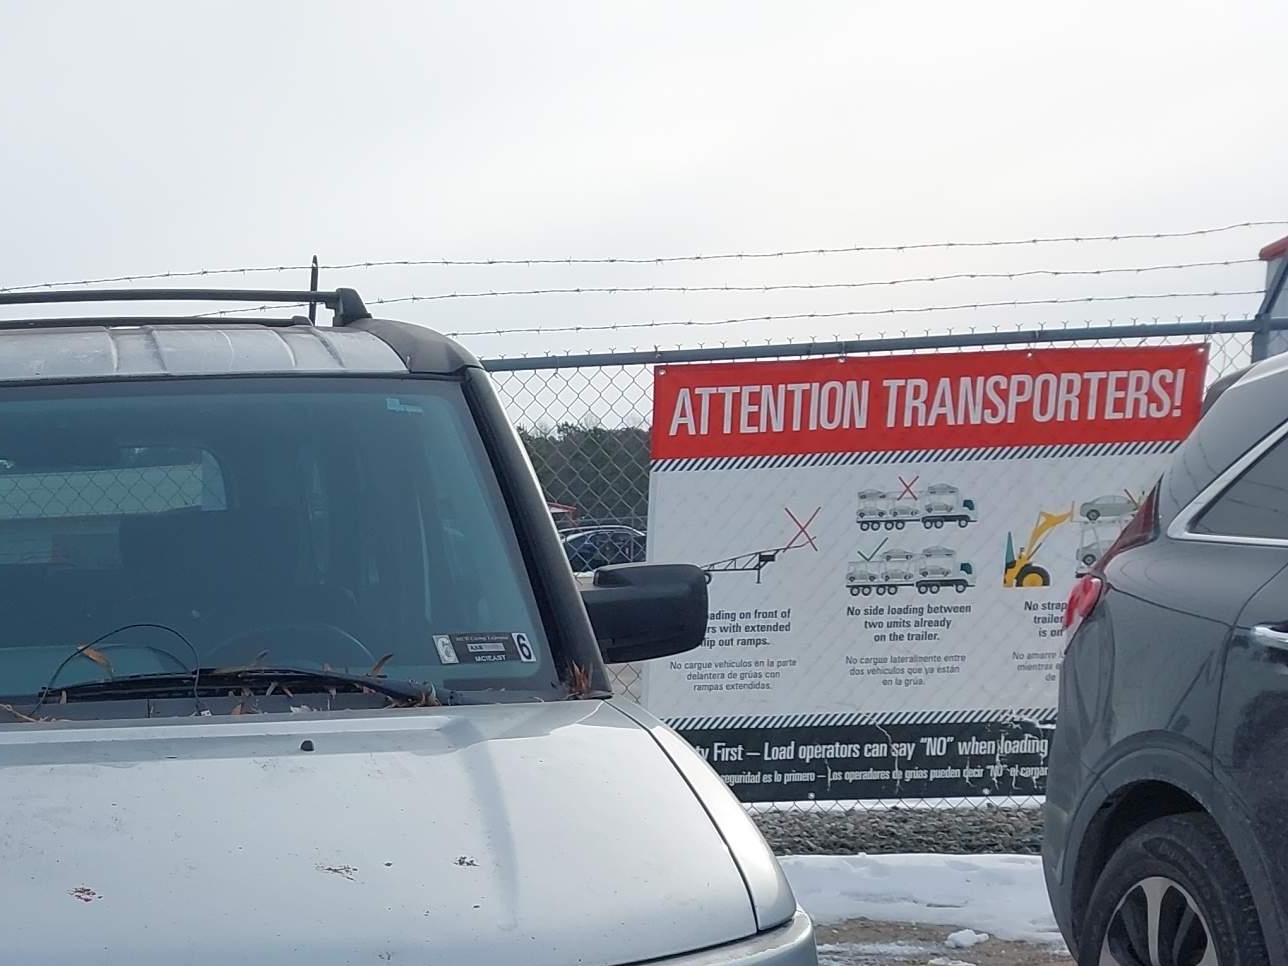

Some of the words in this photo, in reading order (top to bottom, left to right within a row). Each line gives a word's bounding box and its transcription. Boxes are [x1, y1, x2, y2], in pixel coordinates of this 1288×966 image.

[669, 380, 870, 436] ATTENTION
[882, 368, 1186, 428] TRANSPORTERS!
[846, 605, 861, 616] No
[863, 605, 885, 616] side
[887, 604, 925, 617] loading
[926, 603, 972, 615] between
[1024, 601, 1039, 611] No
[709, 609, 737, 621] ading
[739, 611, 752, 620] on
[754, 608, 778, 619] front
[780, 607, 791, 619] of
[1033, 613, 1064, 624] trailer
[719, 622, 742, 633] with
[744, 621, 791, 633] extended
[864, 619, 884, 629] two
[886, 618, 912, 629] units
[914, 617, 952, 630] already
[873, 633, 886, 642] on
[889, 631, 905, 642] the
[907, 630, 940, 642] trailer.
[1038, 627, 1047, 637] is
[516, 633, 532, 661] 6
[718, 638, 734, 647] out
[736, 637, 770, 648] ramps.
[845, 655, 858, 665] No
[859, 656, 888, 666] cargue
[890, 655, 942, 664] lateralmente
[943, 654, 967, 663] entre
[1012, 651, 1025, 660] No
[670, 661, 682, 670] No
[684, 661, 713, 671] cargue
[754, 660, 765, 668] en
[767, 659, 775, 668] la
[777, 659, 797, 669] parte
[686, 671, 725, 681] delantera
[727, 671, 738, 680] de
[765, 671, 781, 679] con
[849, 666, 865, 676] dos
[907, 666, 923, 676] que
[924, 666, 935, 677] ya
[1045, 673, 1057, 682] de
[693, 683, 724, 692] rampas
[882, 678, 893, 686] en
[713, 742, 745, 762] First
[764, 740, 795, 761] Load
[798, 741, 861, 763] operators
[863, 742, 888, 758] can
[891, 742, 916, 761] say
[957, 735, 996, 756] when
[1000, 733, 1049, 758] loading
[762, 773, 773, 783] es
[774, 770, 782, 783] lo
[784, 769, 816, 785] primero
[828, 768, 843, 782] Los
[844, 767, 891, 783] operadores
[892, 767, 903, 780] de
[929, 766, 961, 782] pueden
[963, 765, 984, 778] decir
